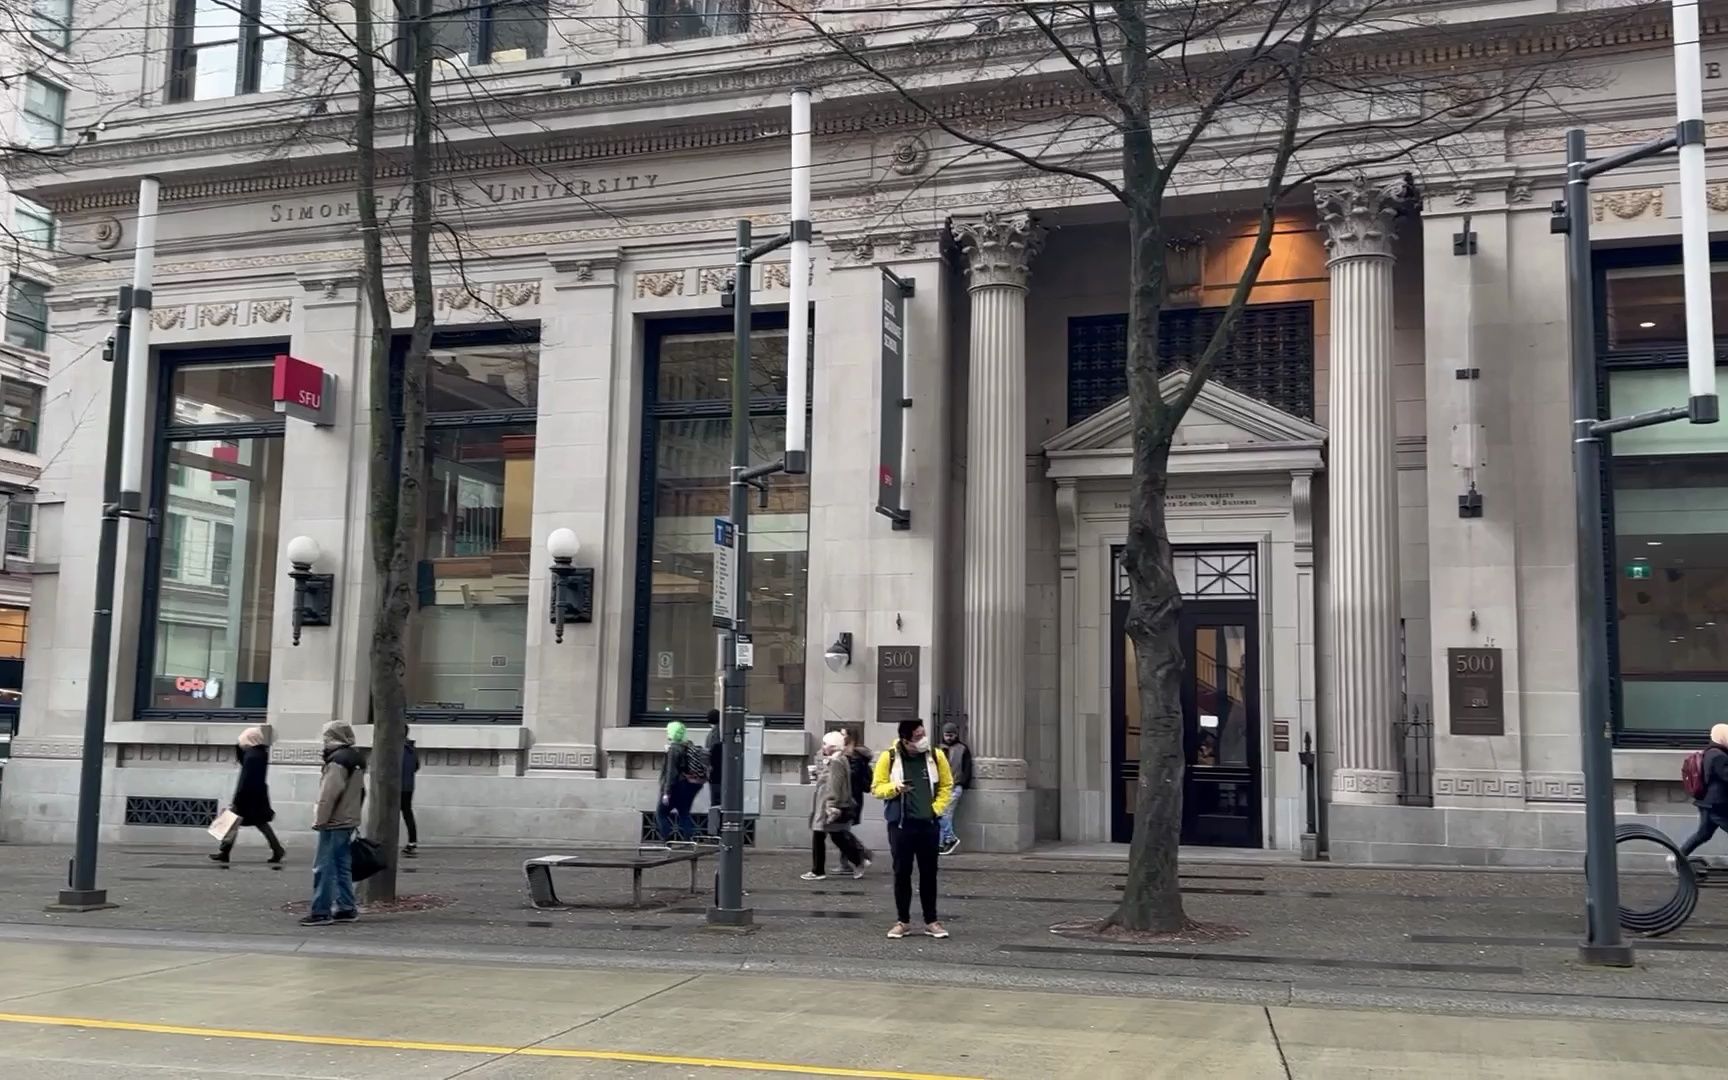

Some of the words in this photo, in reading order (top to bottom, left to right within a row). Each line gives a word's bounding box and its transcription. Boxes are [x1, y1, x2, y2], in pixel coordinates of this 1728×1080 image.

[270, 203, 350, 223] SIMON
[487, 174, 658, 203] UNIVERSITY
[298, 390, 321, 408] SFU
[884, 650, 913, 667] 500
[1456, 654, 1494, 672] 500
